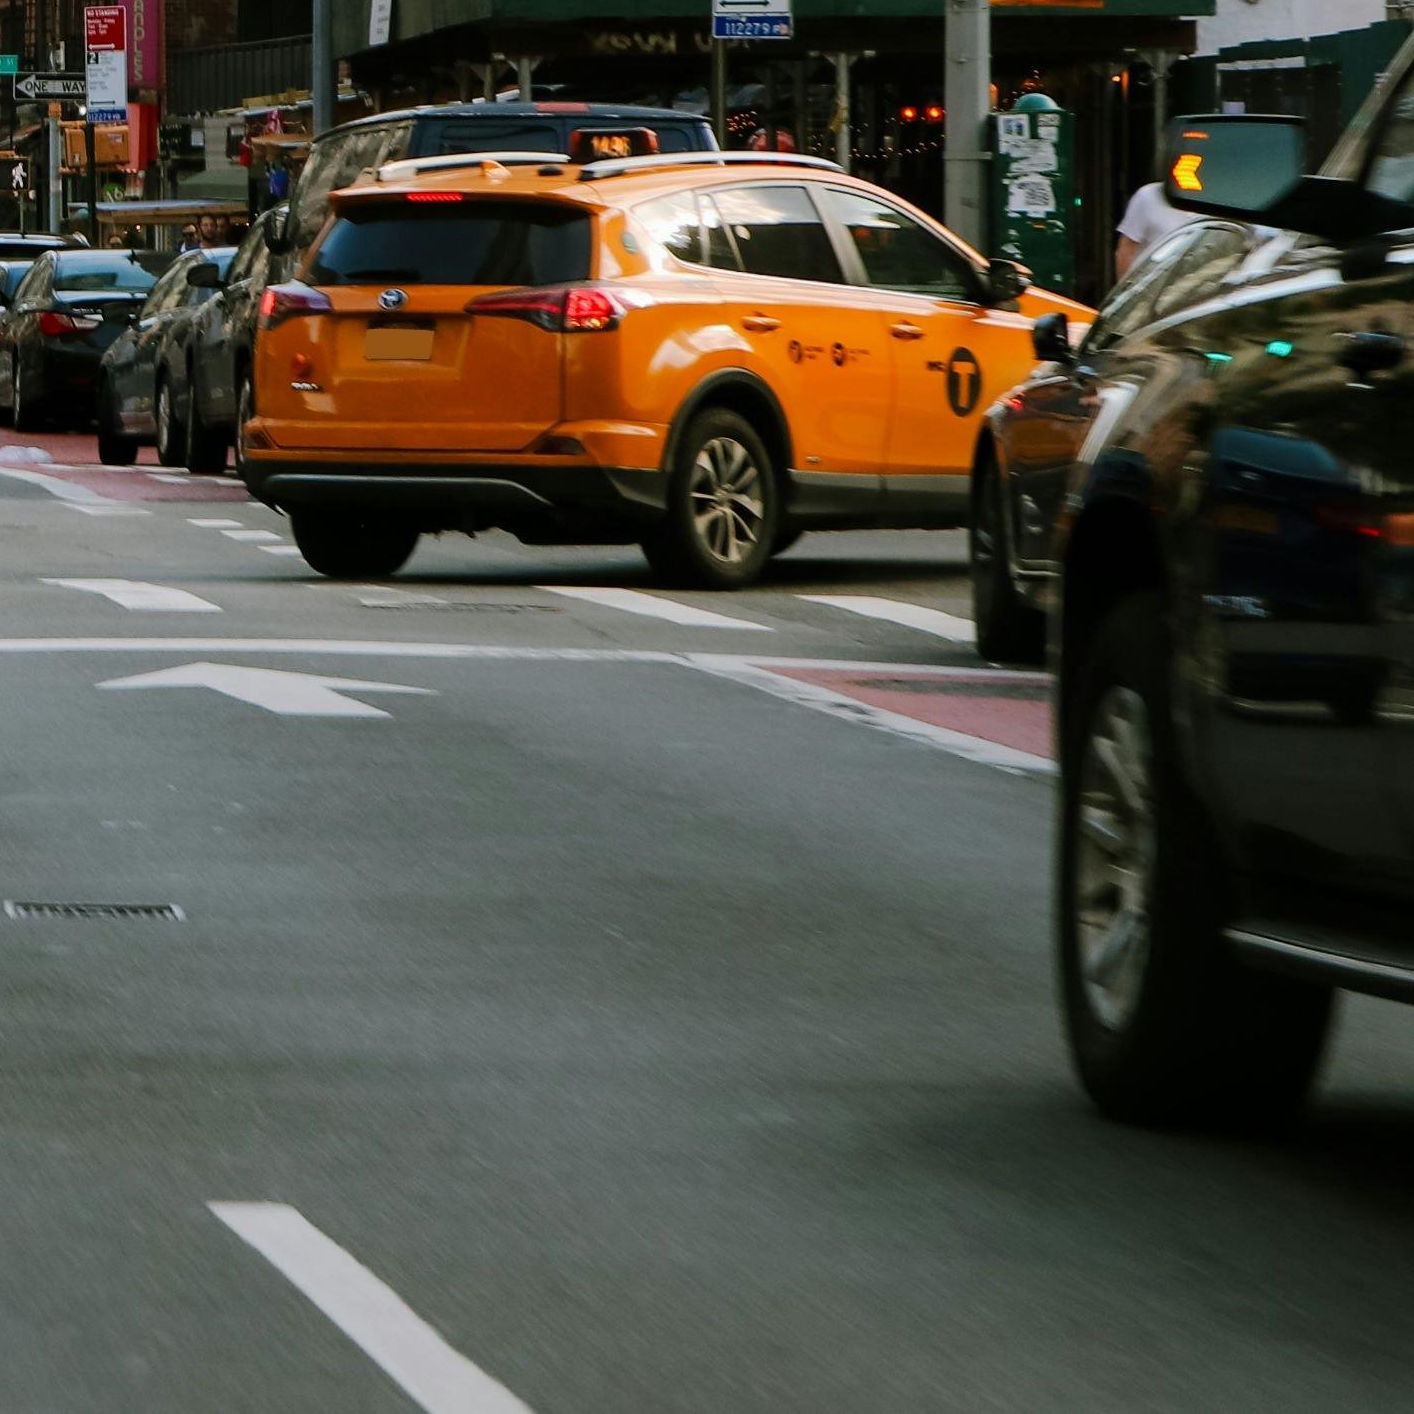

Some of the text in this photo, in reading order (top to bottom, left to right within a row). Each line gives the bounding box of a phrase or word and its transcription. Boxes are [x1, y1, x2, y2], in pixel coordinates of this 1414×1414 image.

[724, 22, 771, 35] 112279
[25, 81, 48, 92] ONE
[62, 81, 87, 92] WAY
